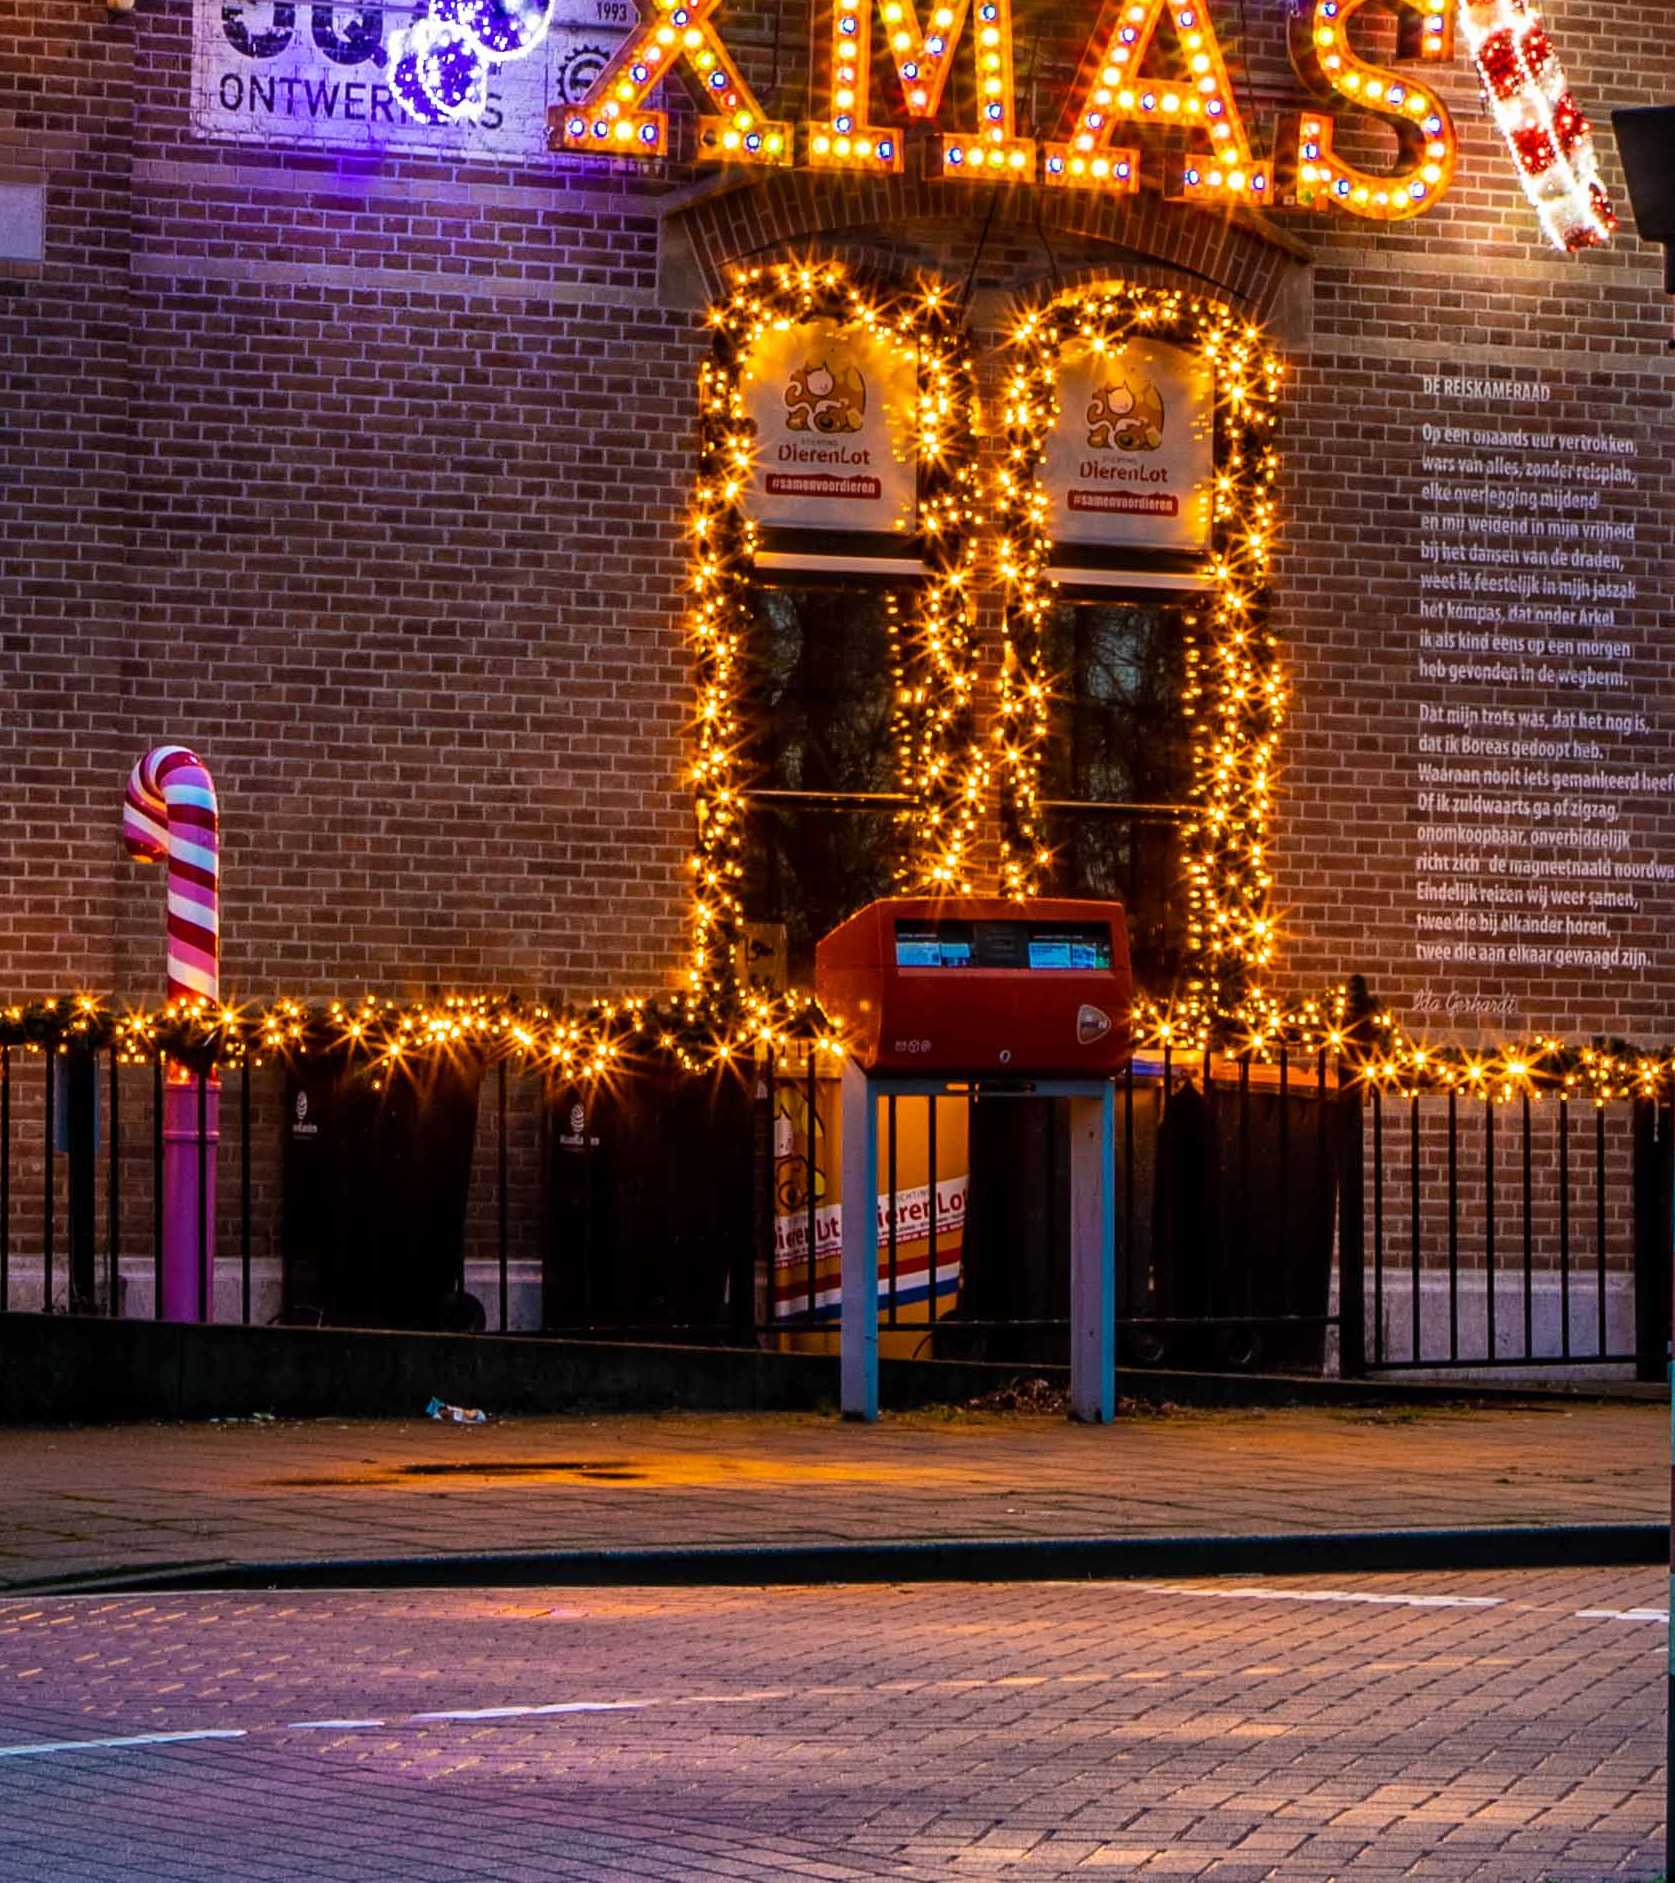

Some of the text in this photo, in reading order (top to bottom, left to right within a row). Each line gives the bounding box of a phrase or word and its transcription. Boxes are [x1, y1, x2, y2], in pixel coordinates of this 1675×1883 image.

[596, 2, 627, 22] 1993
[1423, 378, 1550, 403] DE REISKAMERAAD
[1422, 423, 1440, 445] Op
[1444, 427, 1470, 444] een
[1558, 434, 1639, 457] vertrokken,
[778, 444, 870, 465] DierenLot
[1080, 461, 1168, 483] DierenLot
[1422, 456, 1636, 485] wars van alles, zonder reisplan,
[771, 477, 875, 494] #samenvoordieren
[1421, 483, 1598, 511] elke overlegging mijdend
[1421, 515, 1635, 543] en mij weidend in mijn vrijheid
[1420, 541, 1625, 571] bij het dansen van de draden,
[1420, 571, 1635, 601] weet ik feestelijk in mijn jaszak
[1420, 600, 1614, 626] het kompas, dat onder Arkel
[1419, 628, 1630, 660] ik als kind eens op een morgen
[1419, 657, 1629, 689] heb gevonden in de wegberm.
[1419, 703, 1650, 736] Dat mijn trots was, dat het nog is,
[1418, 734, 1603, 760] dat ik Boreas gedoopt heb.
[1418, 763, 1481, 783] Waaraan
[1484, 766, 1520, 785] nooit
[1523, 767, 1549, 786] iets
[1552, 771, 1639, 791] gemankeerd
[1417, 793, 1620, 822] Of ik zuidwaarts ga of zigzag,
[1417, 823, 1629, 853] onomkoopbaar, onverbiddelijk
[1416, 852, 1449, 871] richt
[1452, 853, 1479, 872] zich
[1488, 854, 1506, 872] de
[1509, 856, 1611, 878] magneetnaald
[1416, 882, 1639, 909] Eindelijk reizen wij weer samen,
[1416, 912, 1611, 938] twee die bij elkander horen,
[1415, 943, 1652, 969] twee die aan elkaar gewaagd zijn.
[1412, 988, 1517, 1016] Ida Gerhardt
